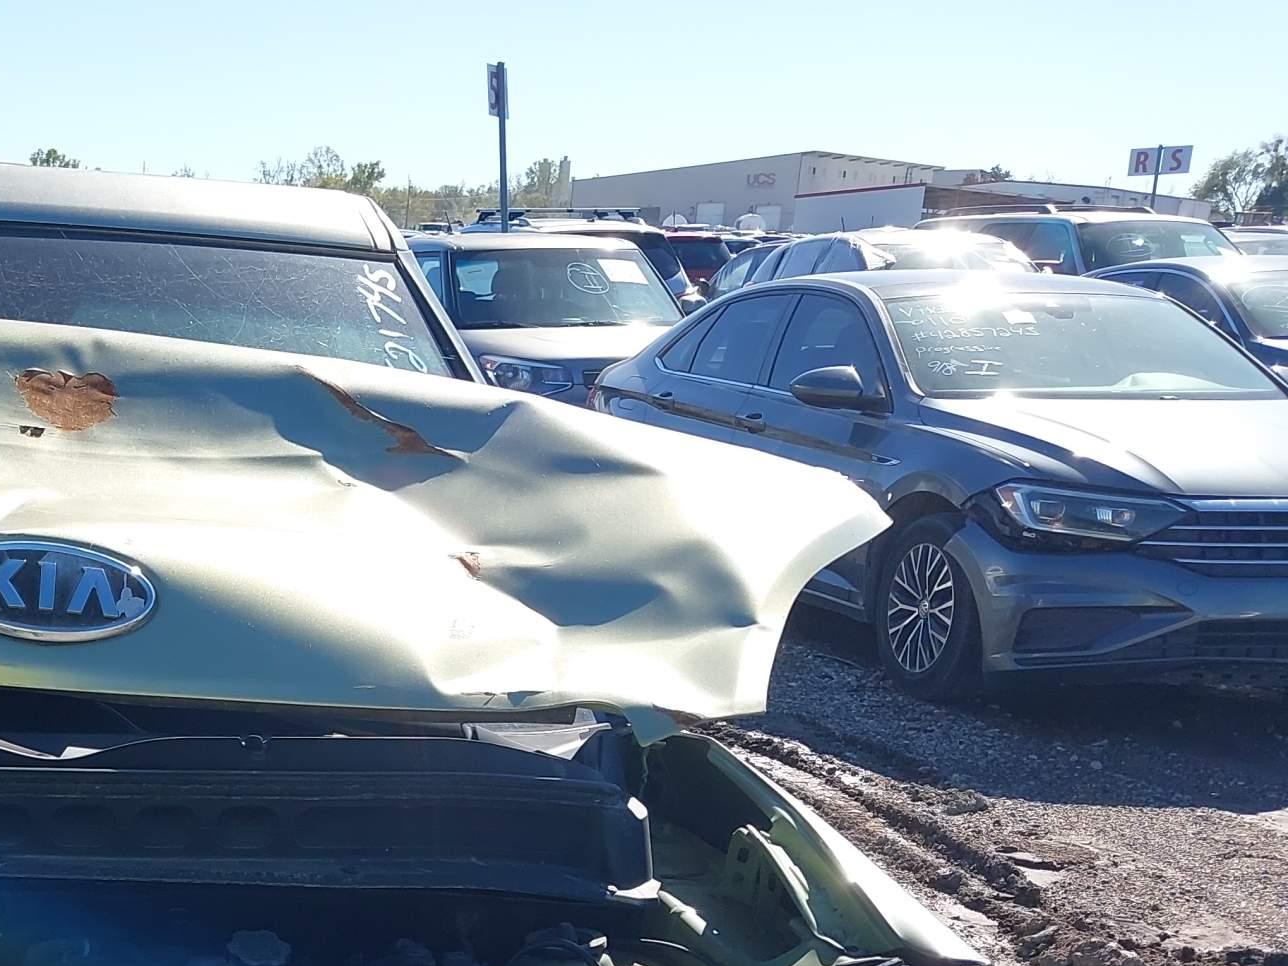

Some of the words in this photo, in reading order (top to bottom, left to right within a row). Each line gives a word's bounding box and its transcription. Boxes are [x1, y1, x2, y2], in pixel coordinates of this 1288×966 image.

[1134, 151, 1149, 173] R
[1169, 148, 1183, 171] S
[746, 173, 777, 185] UCS
